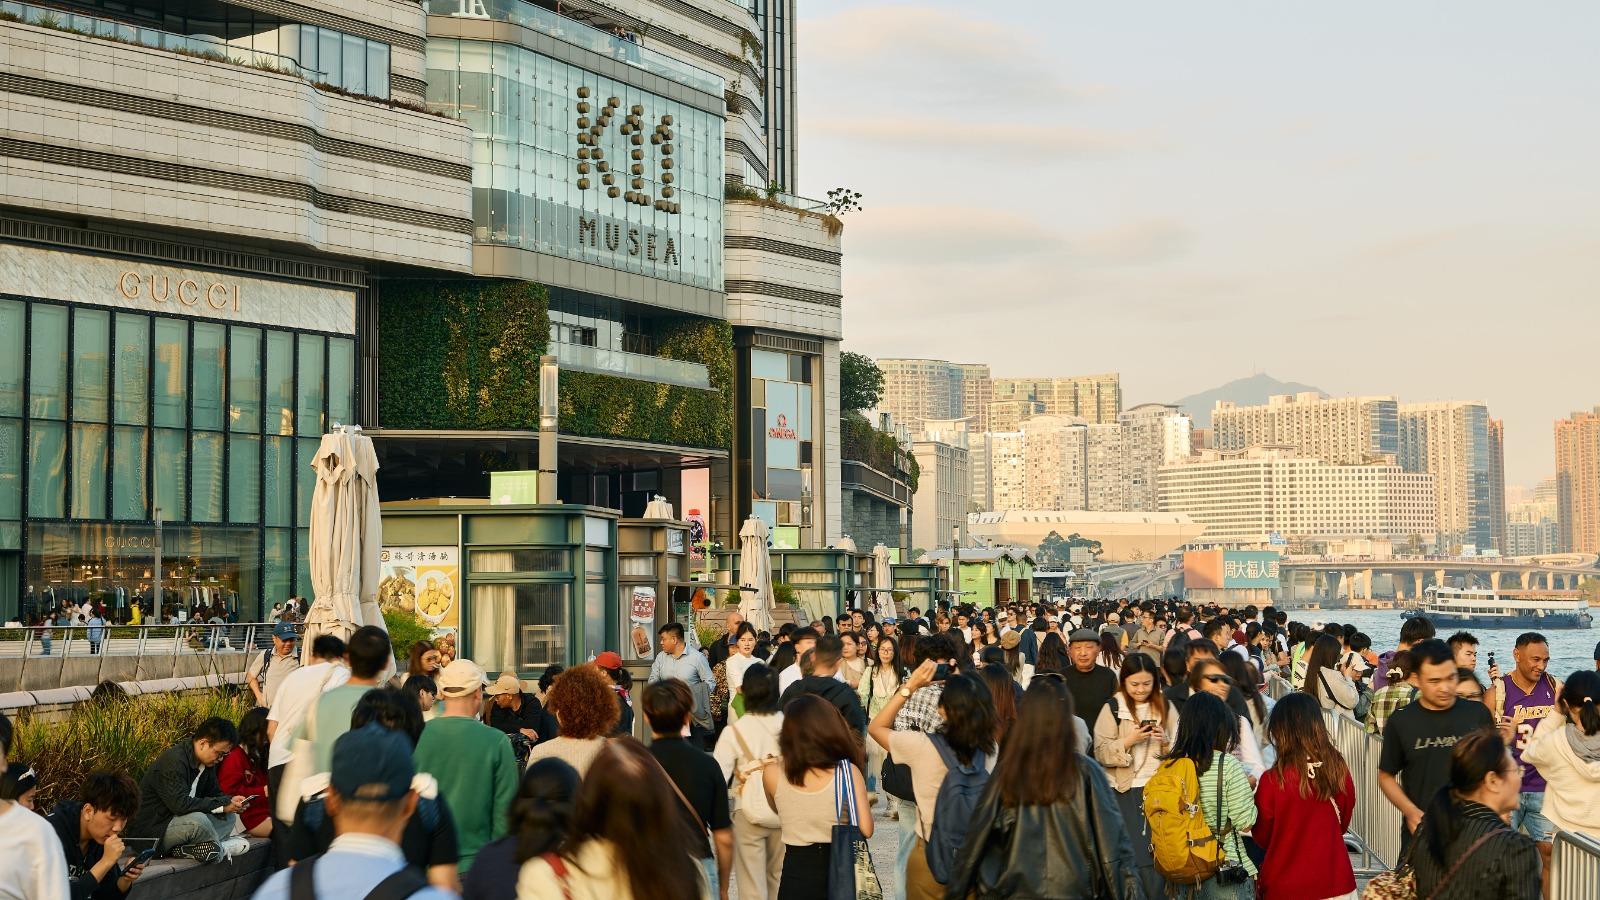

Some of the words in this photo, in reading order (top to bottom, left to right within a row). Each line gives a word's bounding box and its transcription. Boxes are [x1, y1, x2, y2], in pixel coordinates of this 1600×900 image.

[577, 86, 681, 214] K11
[579, 215, 678, 266] MUSEA
[120, 271, 240, 312] GUCCI
[105, 535, 155, 548] GUCCI
[1224, 560, 1279, 579] 周大福人壽
